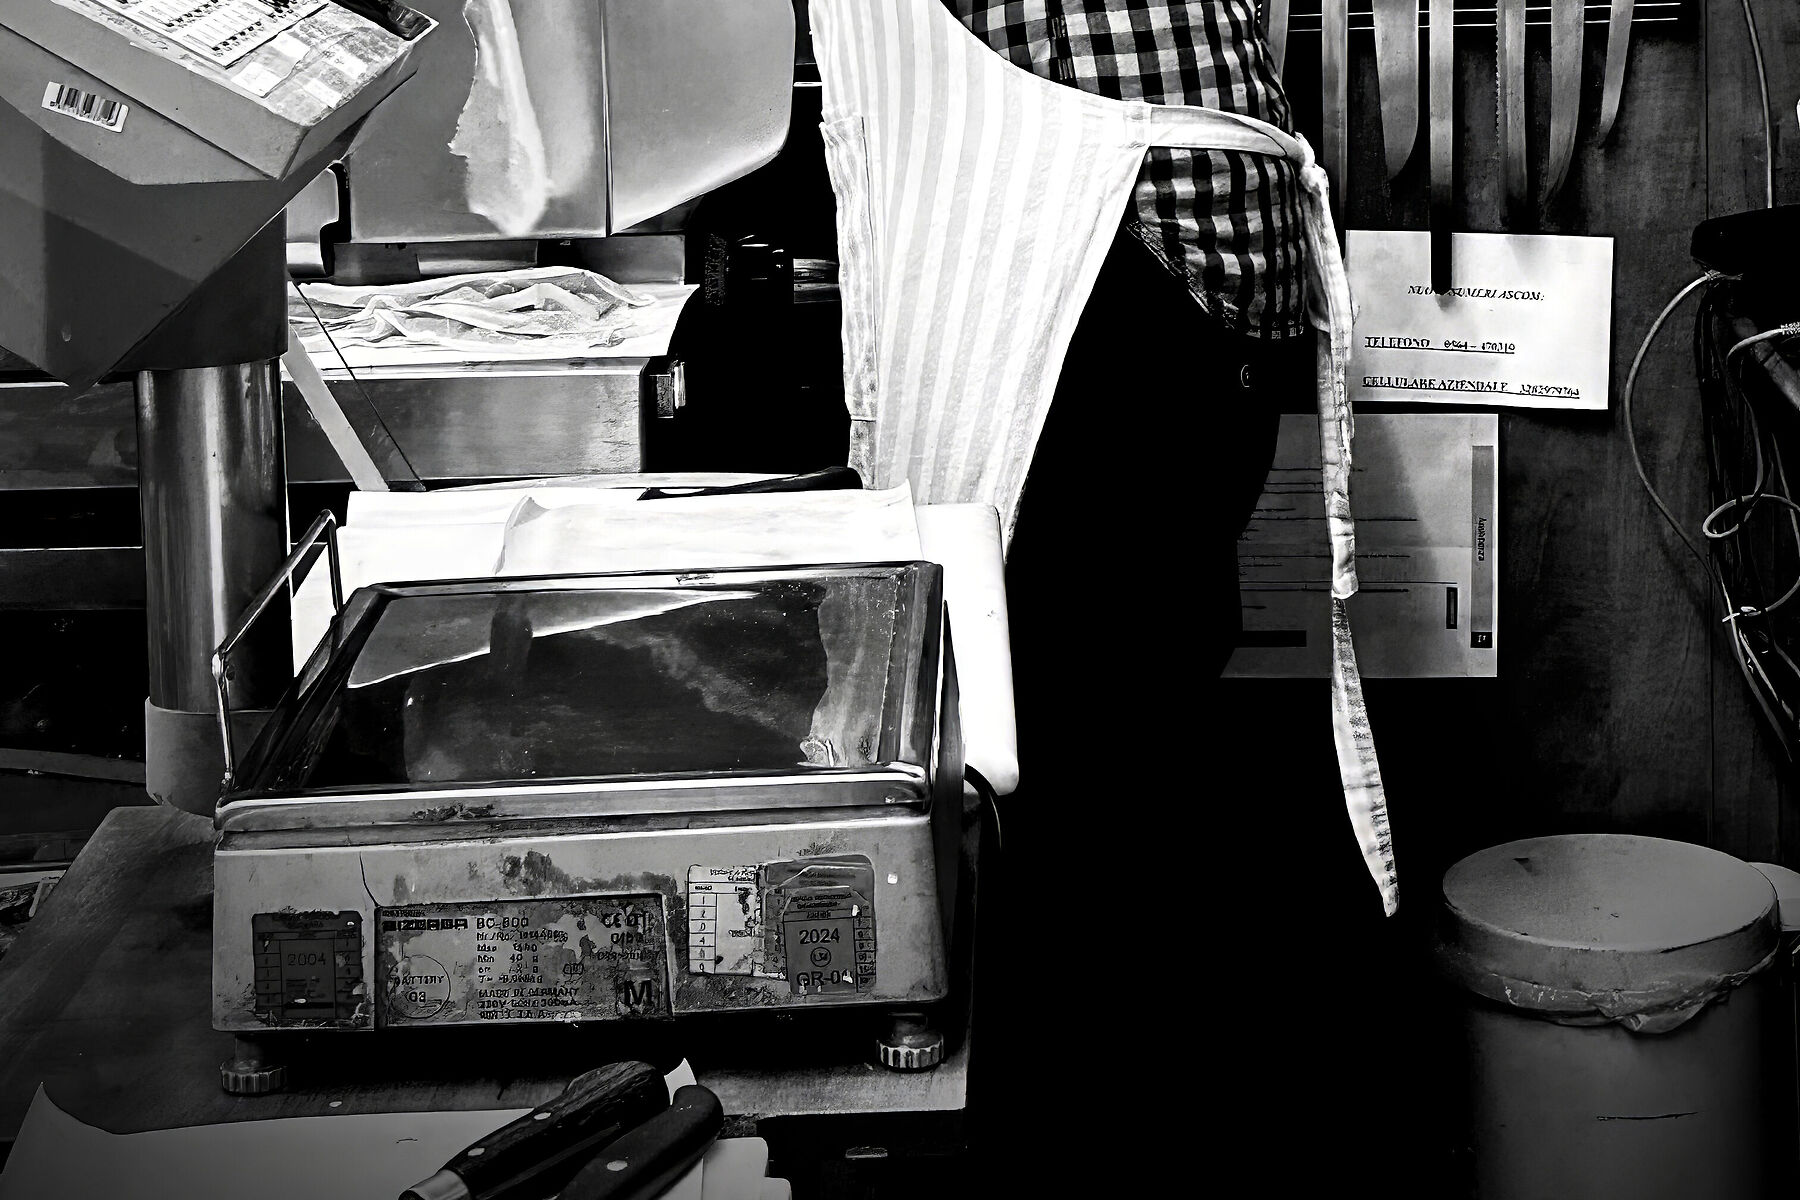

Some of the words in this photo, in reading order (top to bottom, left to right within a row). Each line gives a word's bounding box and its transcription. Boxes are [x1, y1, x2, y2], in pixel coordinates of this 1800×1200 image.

[1364, 335, 1431, 348] TELEFONO
[1362, 375, 1437, 390] CELLULARE
[798, 927, 841, 946] 2024
[622, 979, 654, 1008] M
